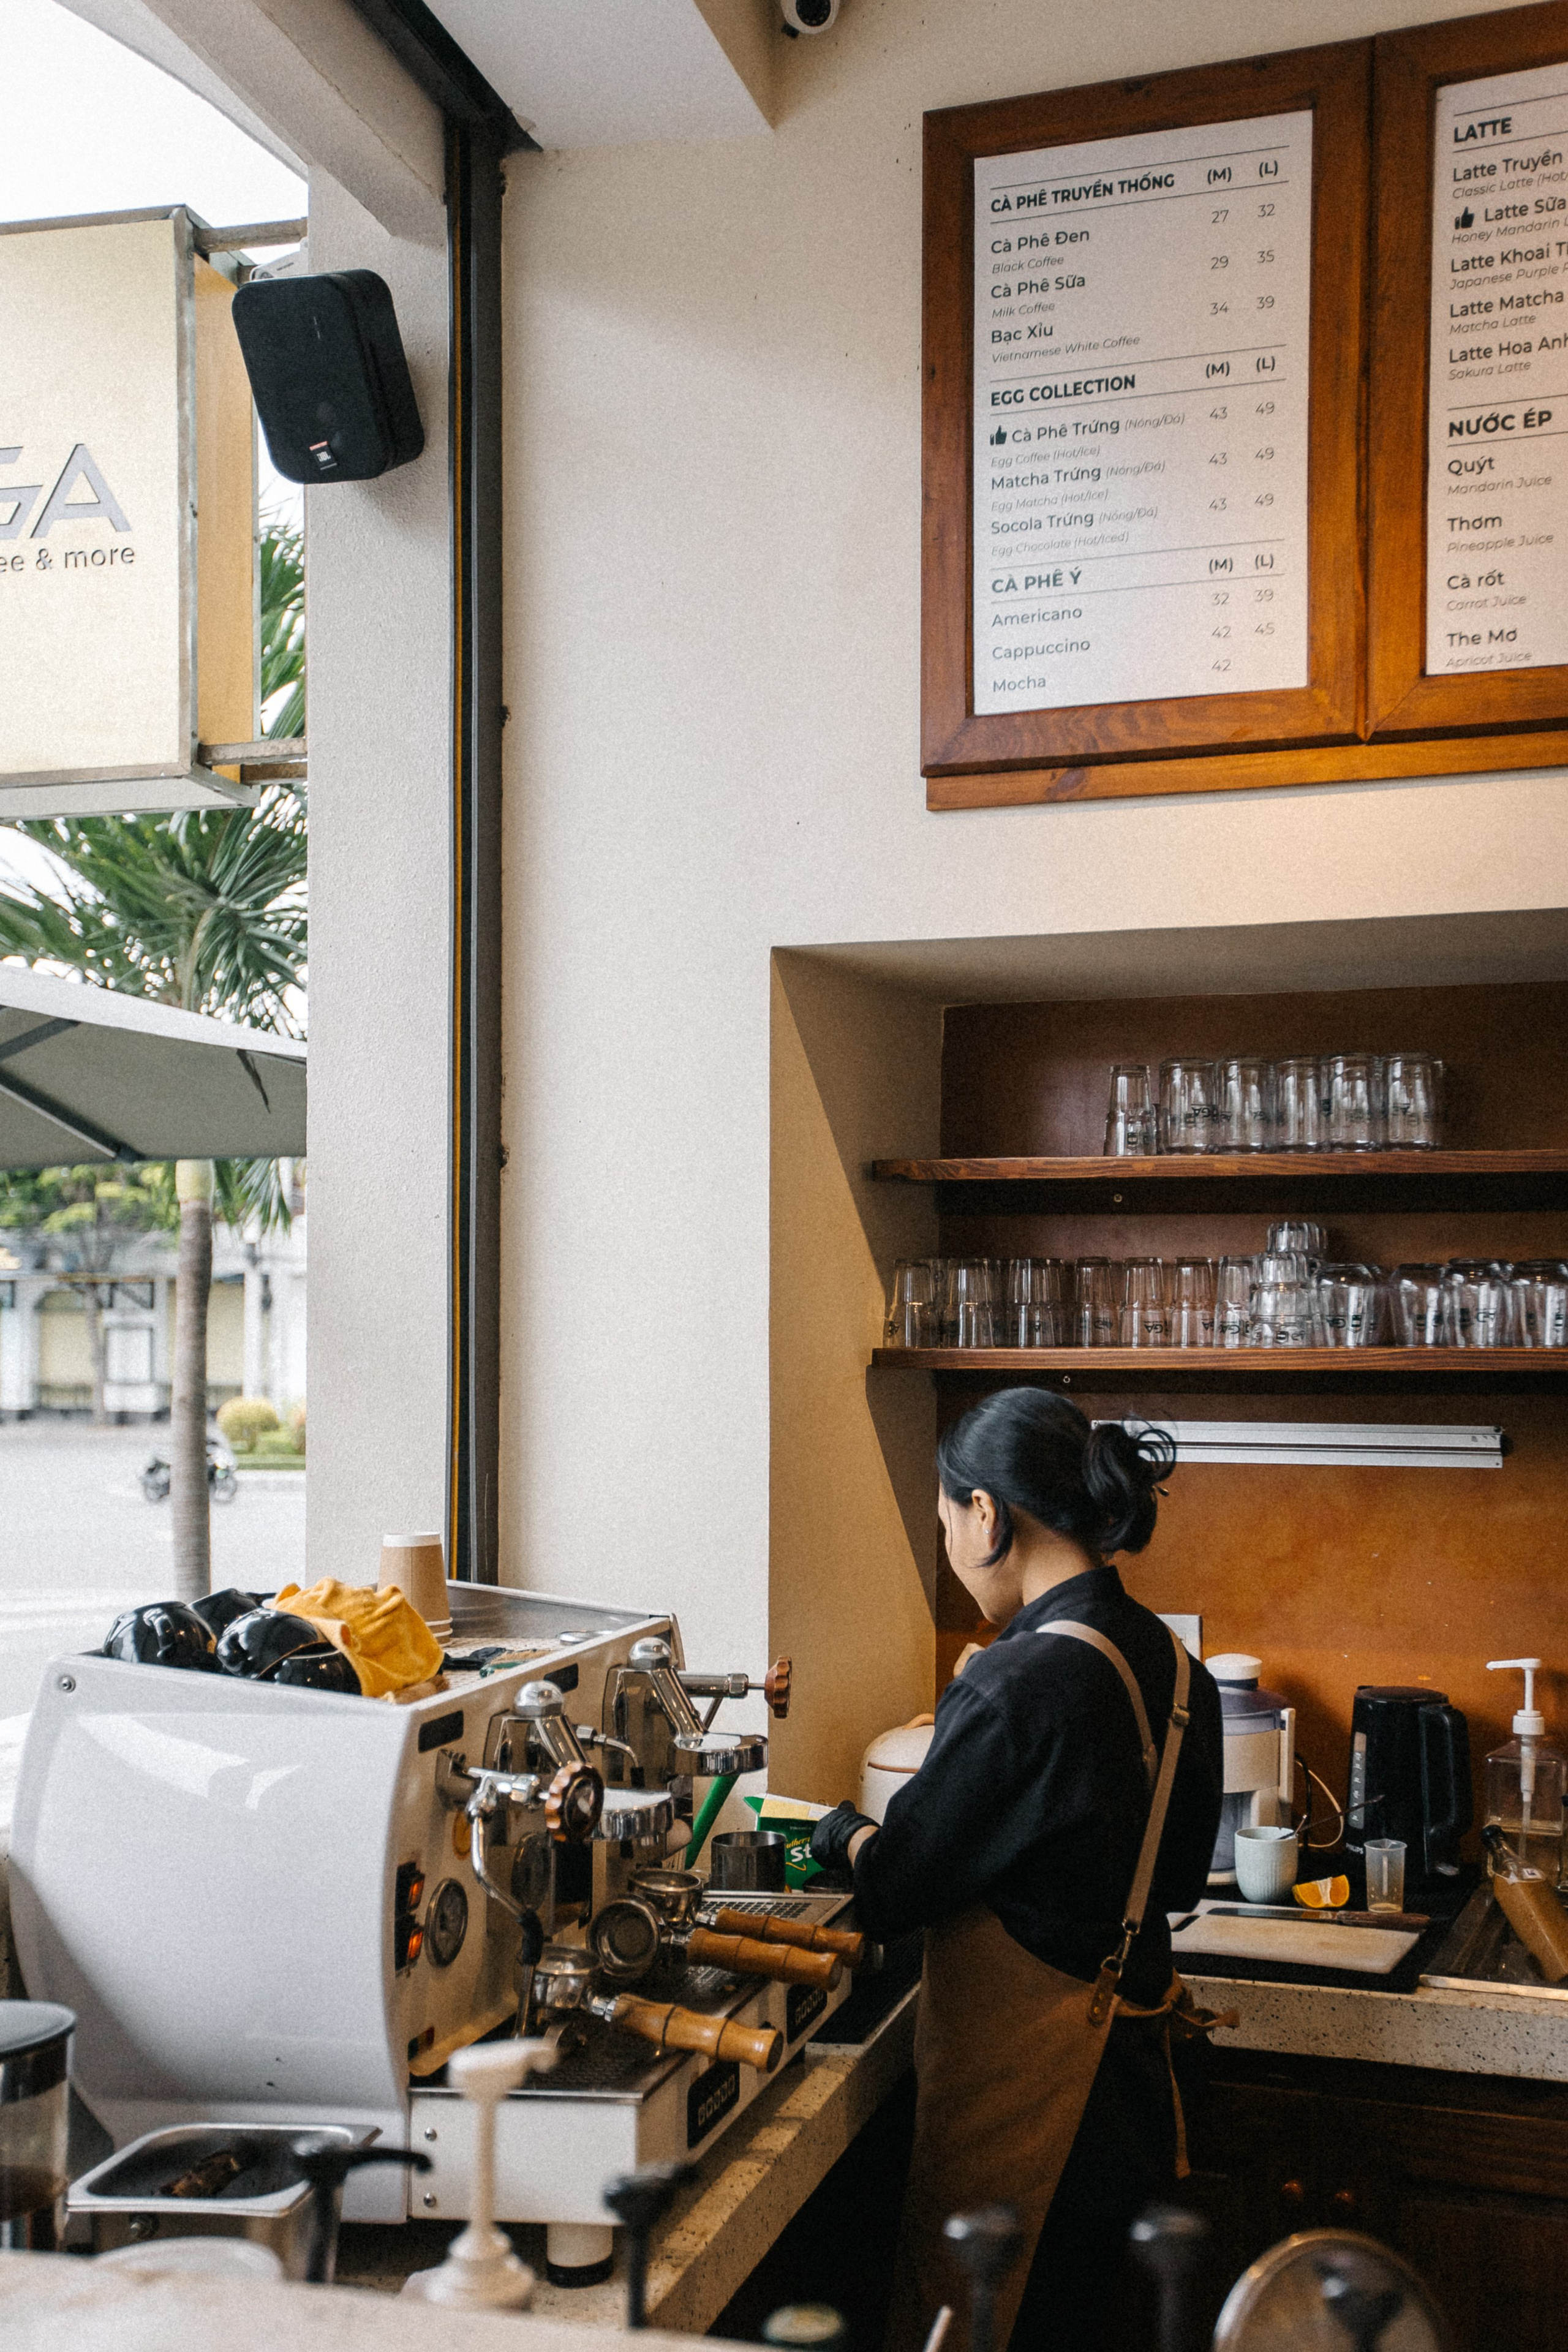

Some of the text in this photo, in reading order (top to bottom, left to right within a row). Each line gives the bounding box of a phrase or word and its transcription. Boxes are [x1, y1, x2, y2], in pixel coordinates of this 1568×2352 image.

[1454, 118, 1512, 143] LATTE
[1453, 164, 1497, 182] Latte
[991, 195, 1012, 213] CÀ
[1017, 189, 1047, 209] PHÊ
[1118, 173, 1174, 194] THỐNG
[1207, 167, 1232, 184] (M)
[1259, 160, 1278, 178] (L)
[1452, 184, 1496, 199] Classic
[1499, 178, 1533, 191] Latte
[1485, 197, 1566, 222] Latte Sữa
[991, 203, 1275, 254] Cà Phê Đen 27 32
[1452, 230, 1491, 244] Honey
[1496, 220, 1559, 236] Mandarin
[992, 257, 1064, 274] Black Coffee
[1451, 255, 1494, 273] Latte
[1501, 243, 1550, 265] Khoai
[991, 250, 1275, 298] Cà Phê Sữa 29 35
[1450, 273, 1512, 290] Japanese
[1517, 264, 1559, 281] Purple
[992, 303, 1055, 318] Milk Coffee
[1450, 290, 1564, 318] Latte Matcha
[991, 295, 1275, 345] Bạc Xỉu 34 39
[1449, 315, 1536, 334] Matcha Latte
[992, 336, 1140, 363] Vietnamese White Coffee
[1450, 347, 1493, 363] Latte
[1499, 342, 1532, 356] Hoa
[991, 356, 1275, 406] EGG COLLECTION (M) (L)
[1449, 362, 1531, 380] Sakura Latte
[1012, 429, 1031, 443] Cà
[1038, 424, 1068, 440] Phê
[1072, 421, 1120, 435] Trứng
[1210, 407, 1227, 419] 43
[1256, 402, 1275, 415] 49
[1449, 408, 1552, 437] NƯỚC ÉP
[991, 445, 1100, 469] Egg Coffee (Hot/Ice)
[992, 473, 1049, 489] Matcha
[1054, 468, 1101, 482] Trứng
[1209, 453, 1227, 465] 43
[1255, 447, 1275, 460] 49
[1447, 456, 1494, 476] Quýt
[1448, 476, 1552, 495] Mandarin Juice
[991, 518, 1042, 534] Socola
[1047, 514, 1093, 527] Trứng
[1209, 498, 1227, 511] 43
[1255, 493, 1274, 506] 49
[992, 489, 1109, 513] Egg Matcha (Hot/Ice)
[1447, 516, 1502, 532] Thơm
[992, 532, 1129, 558] Egg Chocolate (Hot/Iced)
[1447, 535, 1554, 552] Pineapple Juice
[36, 548, 52, 570] &
[64, 546, 135, 568] more
[992, 554, 1274, 593] CÀ PHÊ Ý (M) (L)
[1447, 570, 1504, 590] Cà rốt
[992, 589, 1274, 627] Americano 32 39
[1447, 596, 1527, 611] Carrot Juice
[992, 622, 1275, 660] Cappuccino 42 45
[1447, 629, 1517, 646] The Mơ
[1446, 652, 1532, 667] Apricot Juice
[993, 659, 1231, 692] Mocha 42
